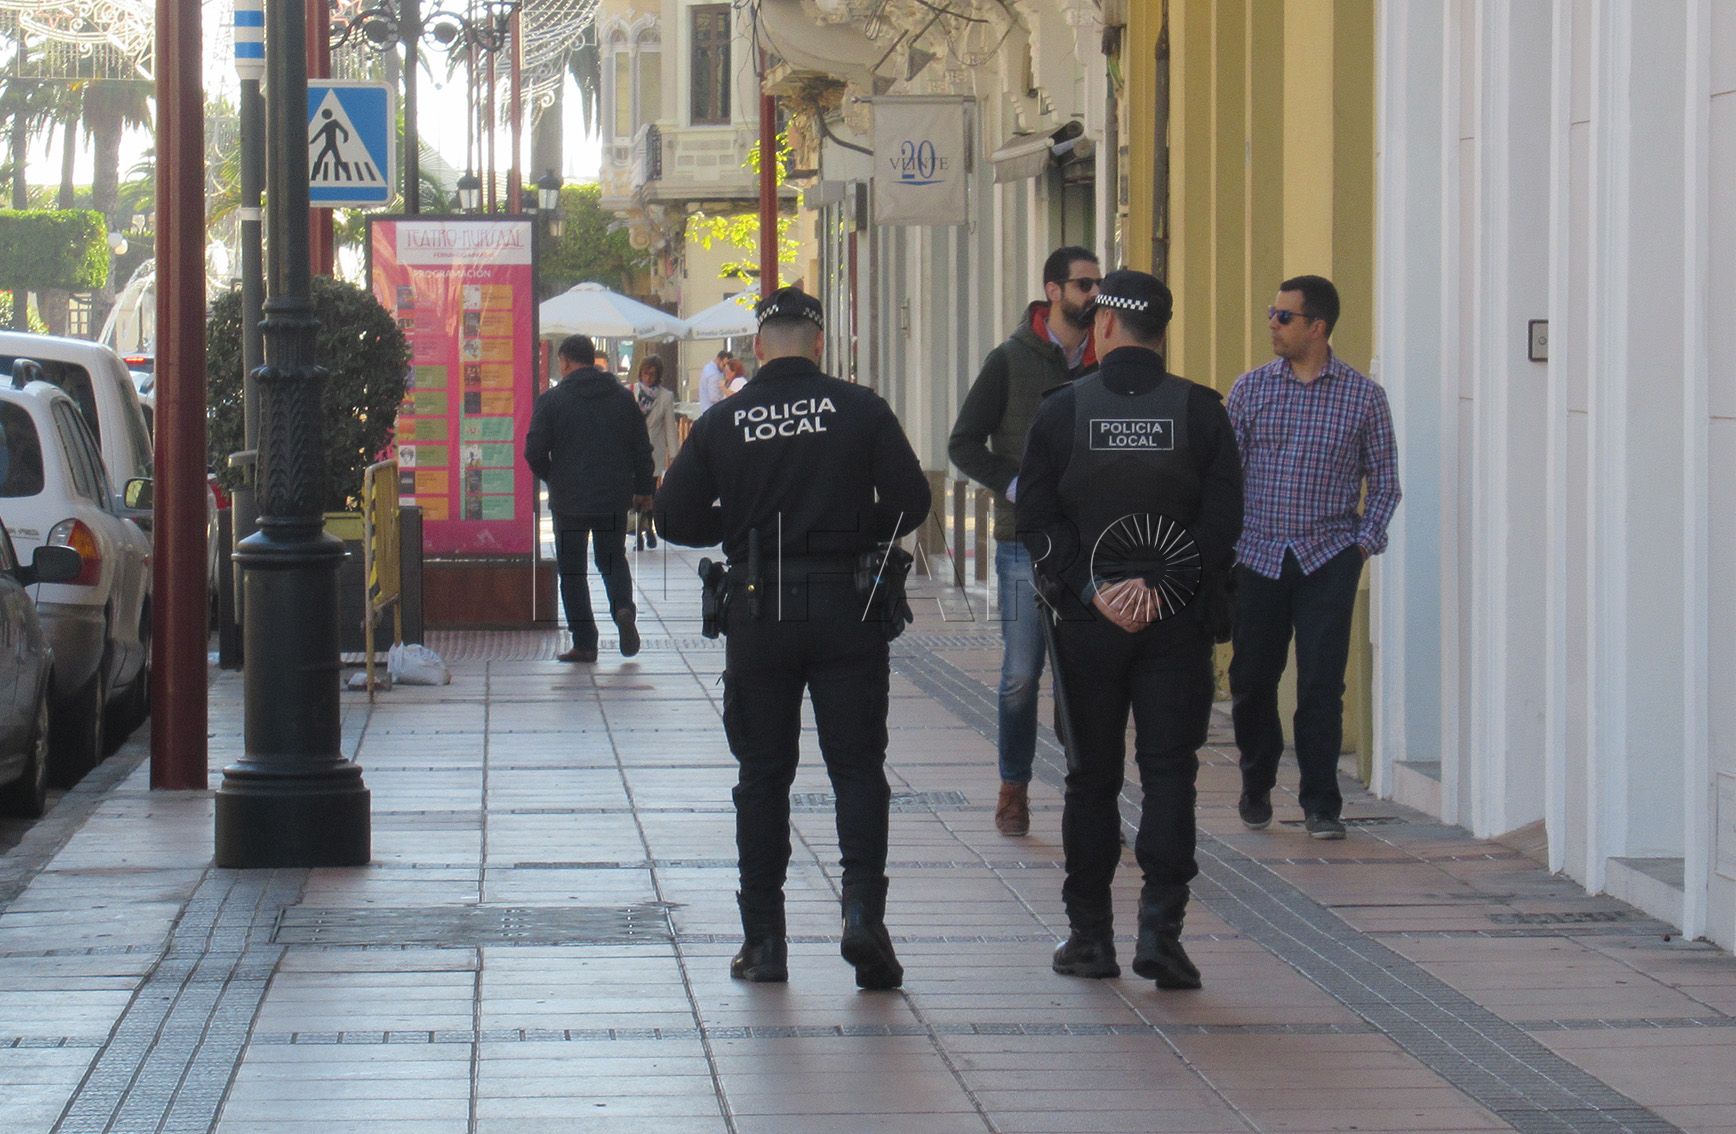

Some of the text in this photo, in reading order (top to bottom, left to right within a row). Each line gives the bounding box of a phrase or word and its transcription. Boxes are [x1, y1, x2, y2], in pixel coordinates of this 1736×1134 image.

[901, 140, 936, 179] 20
[406, 229, 457, 247] TEATRO
[734, 398, 836, 426] POLICIA
[744, 416, 827, 442] LOCAL
[1100, 422, 1163, 434] POLICIA
[1108, 435, 1157, 447] LOCAL
